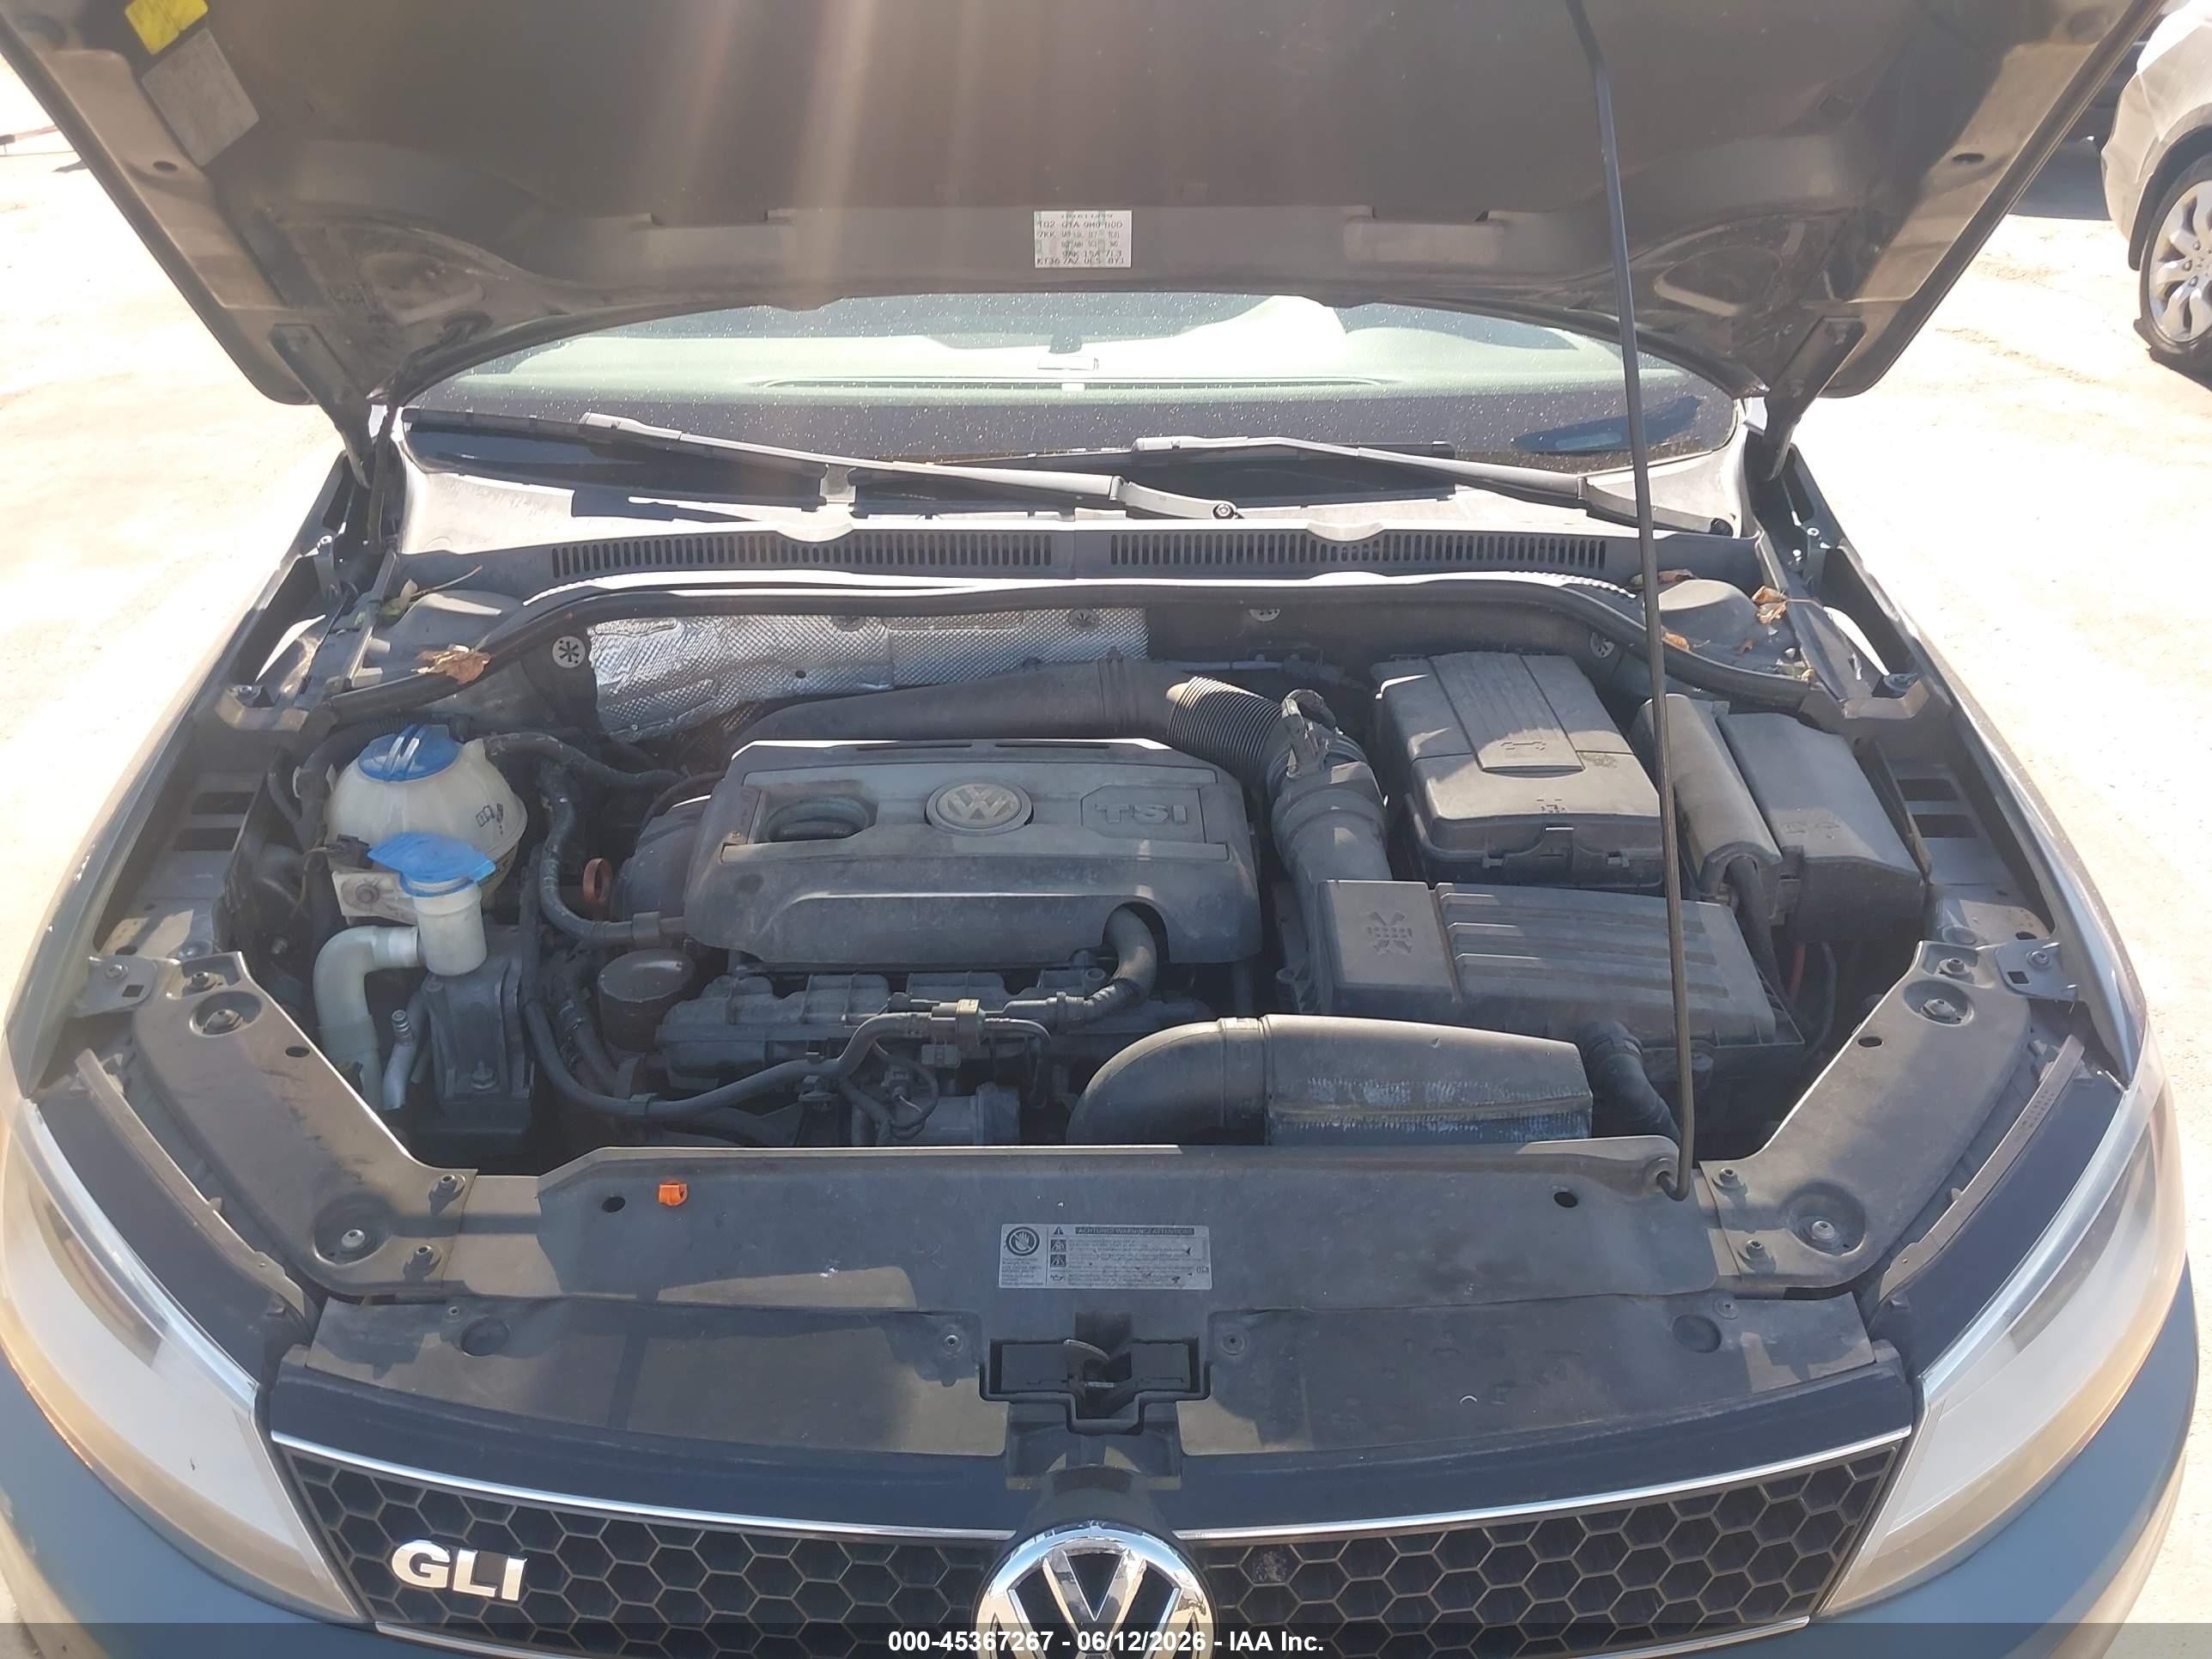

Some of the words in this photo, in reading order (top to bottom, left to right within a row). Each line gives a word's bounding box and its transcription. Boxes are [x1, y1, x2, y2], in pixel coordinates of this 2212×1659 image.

[946, 784, 1013, 820] VW
[1095, 803, 1187, 824] TSI
[392, 1539, 527, 1601] GLI
